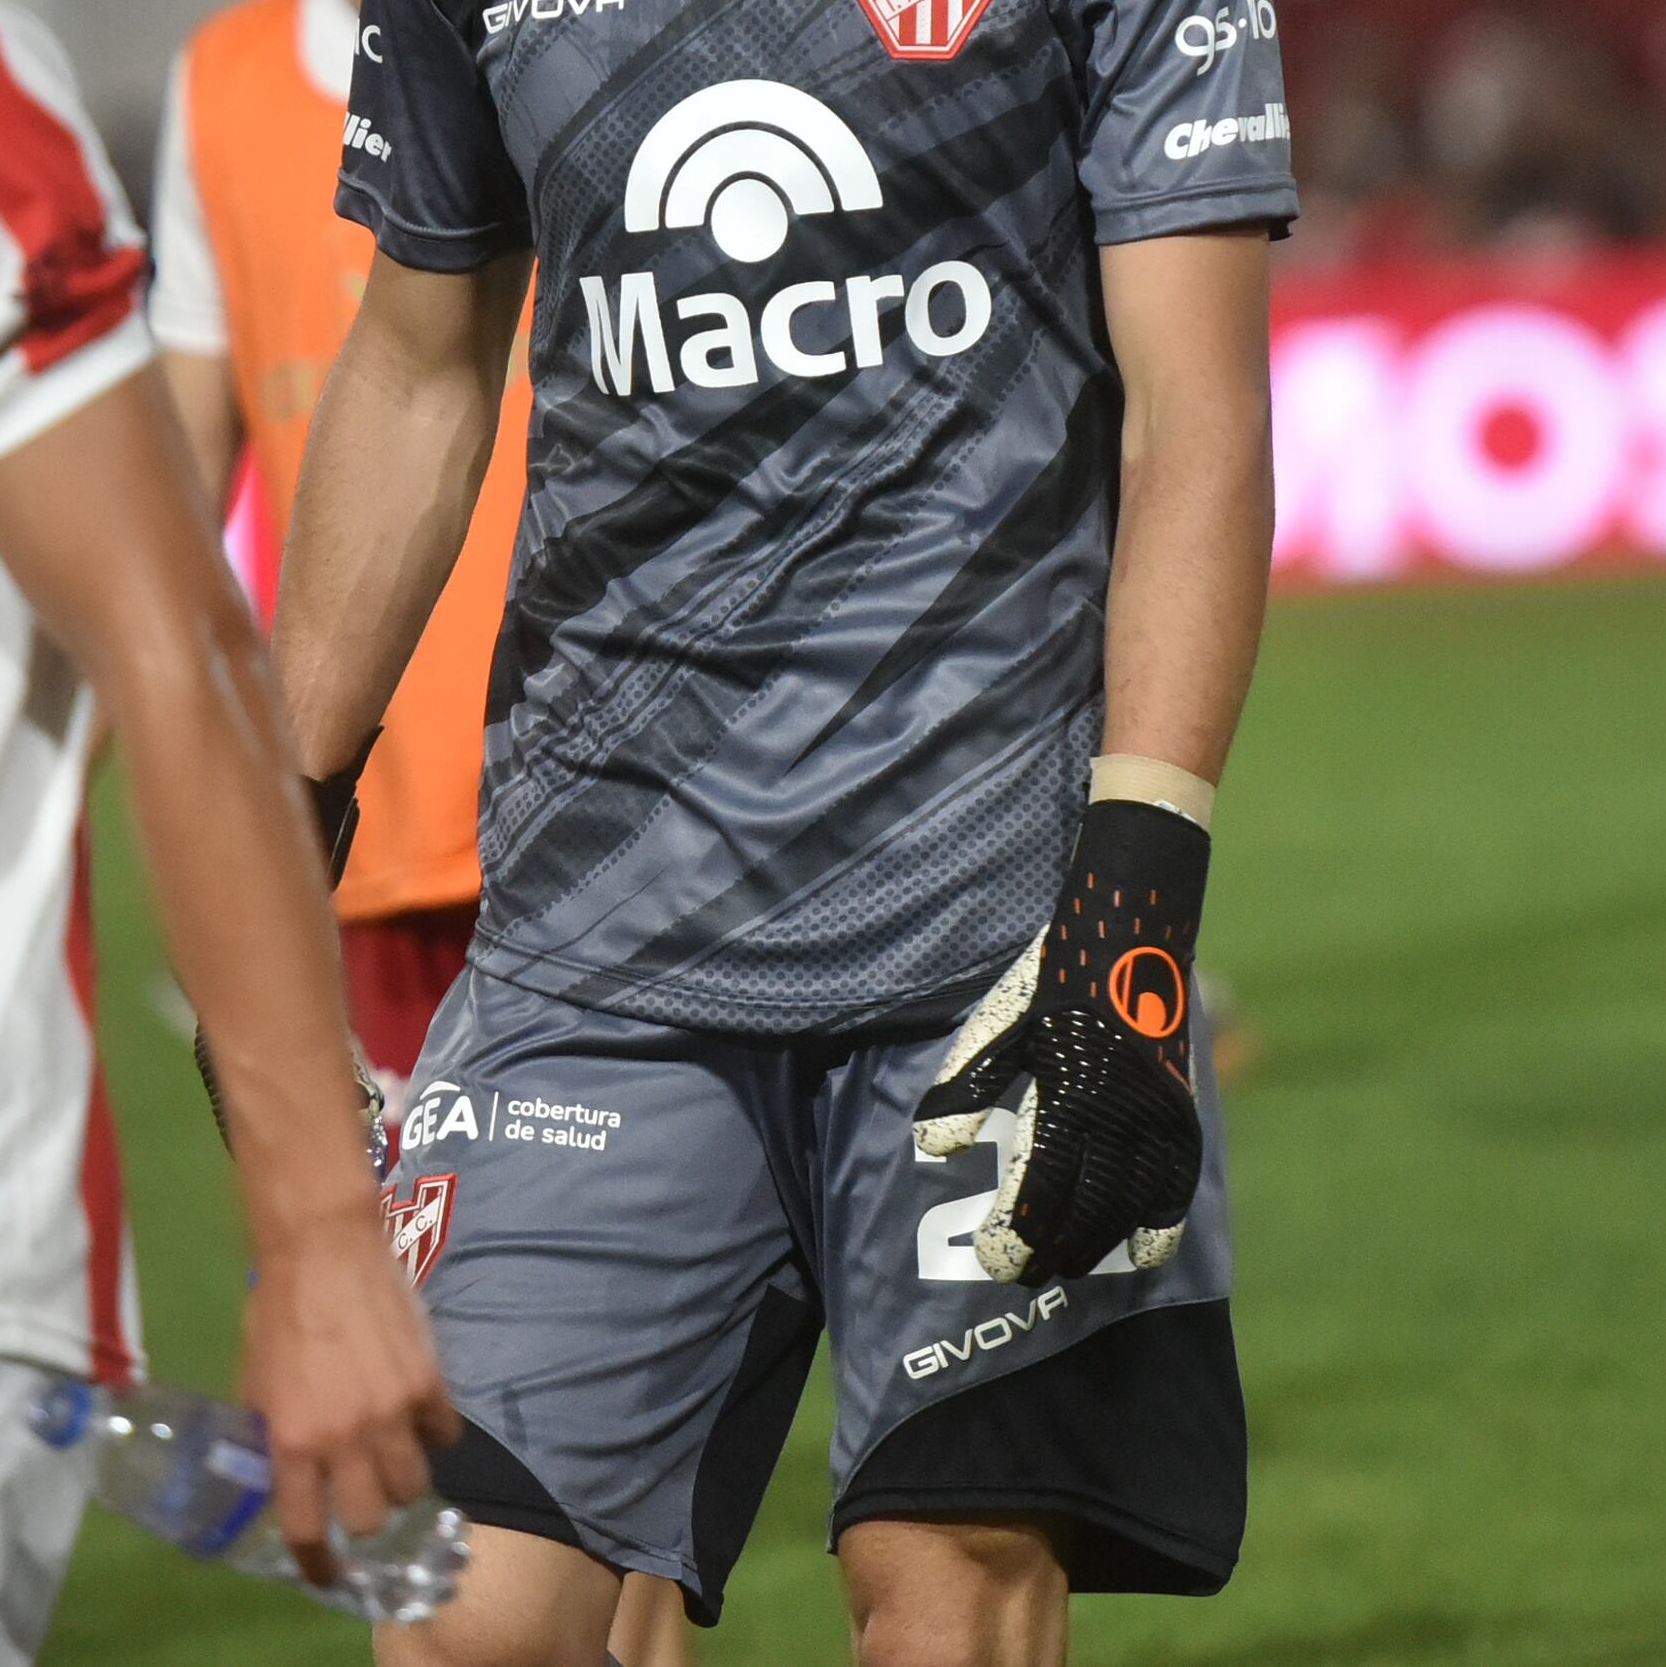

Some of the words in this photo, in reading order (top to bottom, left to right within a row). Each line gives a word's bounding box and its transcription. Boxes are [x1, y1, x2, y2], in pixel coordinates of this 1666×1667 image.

[343, 110, 393, 163] lier
[579, 260, 992, 396] Macro
[504, 1119, 535, 1141] de
[540, 1128, 607, 1151] salud
[506, 1097, 622, 1129] cobertura
[902, 1285, 1068, 1379] GIVOVA
